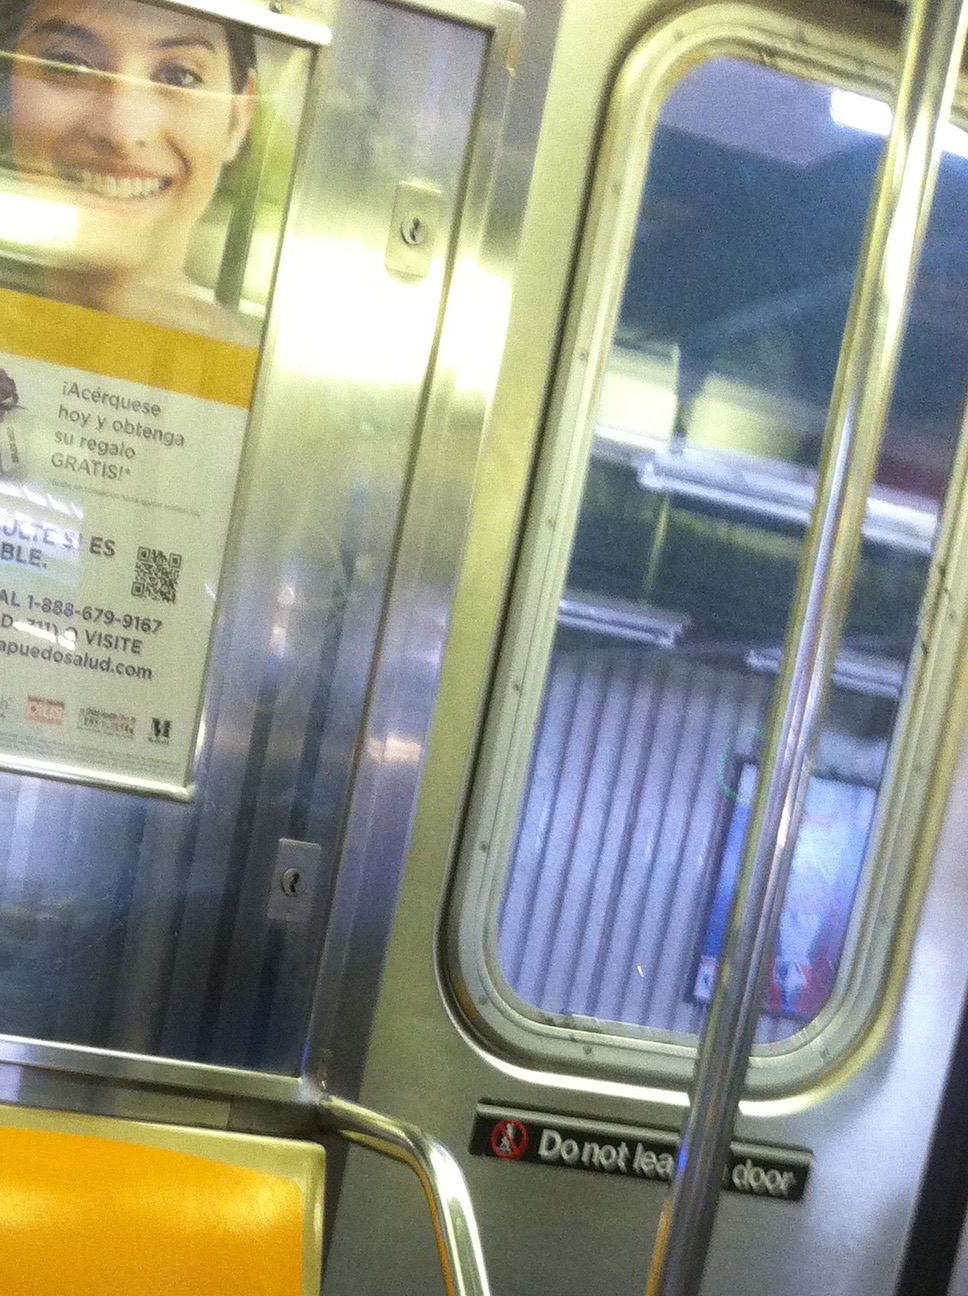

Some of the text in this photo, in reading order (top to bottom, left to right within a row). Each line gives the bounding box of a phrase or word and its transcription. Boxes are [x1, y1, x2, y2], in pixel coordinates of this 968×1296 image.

[56, 403, 186, 449] hoy y obtenga
[53, 428, 137, 462] su regalo
[87, 535, 117, 559] ES
[24, 594, 164, 635] 1-888-679-9167
[82, 629, 143, 655] VISITE
[538, 1128, 578, 1161] Do
[581, 1140, 629, 1174] not
[632, 1142, 674, 1178] lea
[732, 1159, 796, 1198] door
